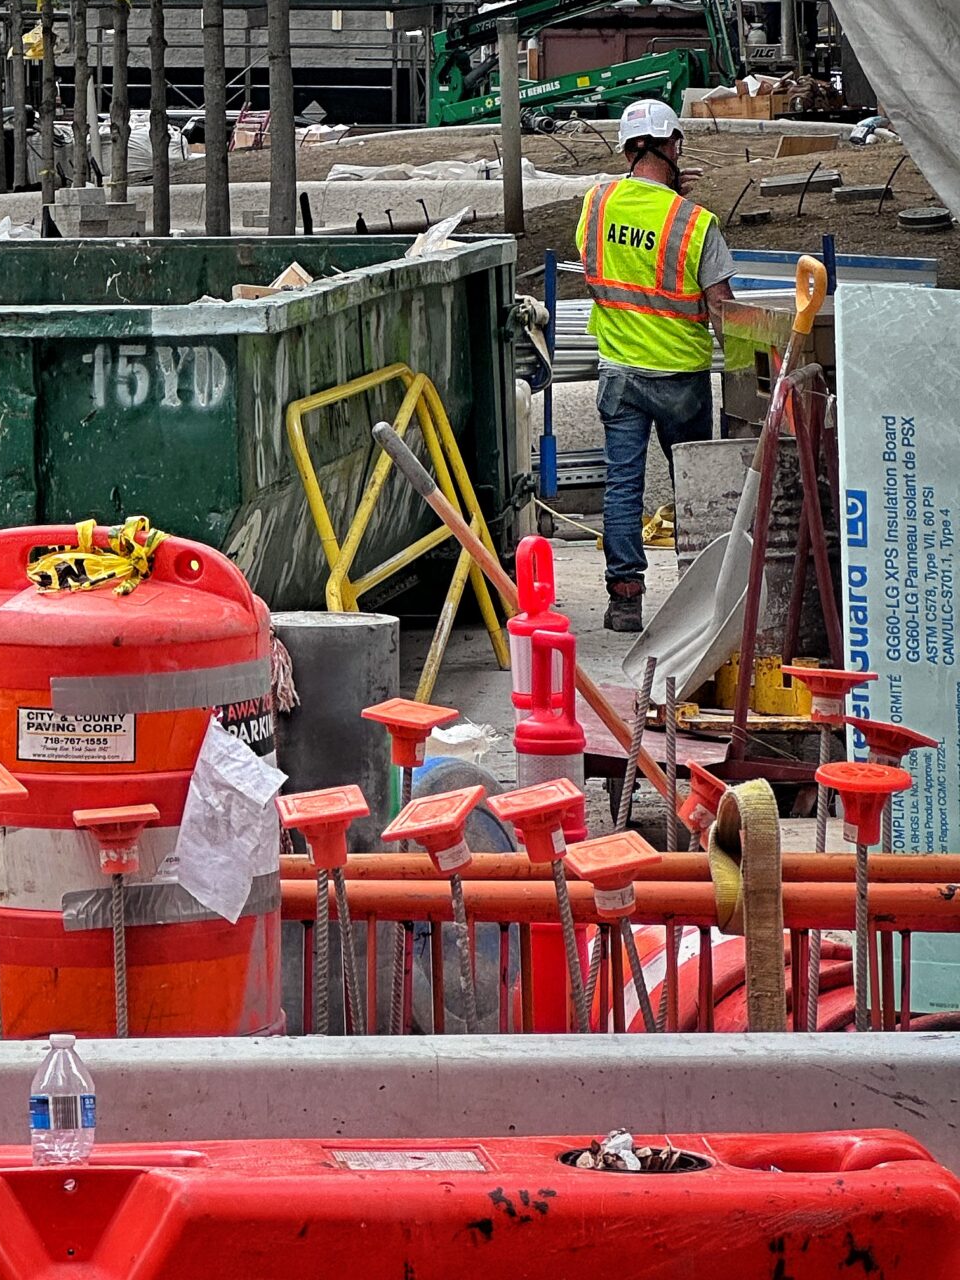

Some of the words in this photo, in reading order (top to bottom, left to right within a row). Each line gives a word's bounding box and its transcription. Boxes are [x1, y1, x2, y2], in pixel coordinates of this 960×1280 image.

[751, 48, 776, 58] JLG
[527, 80, 561, 97] RENTALS
[607, 223, 656, 251] AEWS
[81, 343, 229, 408] 15YD
[881, 415, 897, 462] Board
[901, 416, 915, 448] PSX
[901, 451, 915, 470] de
[882, 466, 899, 543] Insulation
[902, 473, 916, 521] isolant
[922, 486, 935, 508] PSI
[923, 511, 935, 527] 60
[940, 508, 951, 517] 4
[923, 530, 937, 550] VII,
[940, 520, 954, 549] Type
[884, 548, 899, 582] XPS
[904, 524, 918, 588] Panneau
[924, 552, 938, 582] Type
[925, 586, 938, 622] C578,
[886, 586, 901, 661] GG60-LG
[905, 592, 920, 662] GG60-LG
[925, 626, 938, 665] ASTM
[847, 565, 869, 762] reenGuard
[26, 711, 54, 721] CITY
[74, 714, 126, 723] COUNTY
[227, 699, 261, 722] AWAY
[26, 721, 76, 732] PAVING
[82, 723, 127, 733] CORP.
[43, 736, 109, 746] 718-767-1555
[937, 776, 947, 806] CCMC
[924, 796, 934, 829] Product
[938, 807, 949, 843] Rapport
[925, 831, 934, 854] lorida
